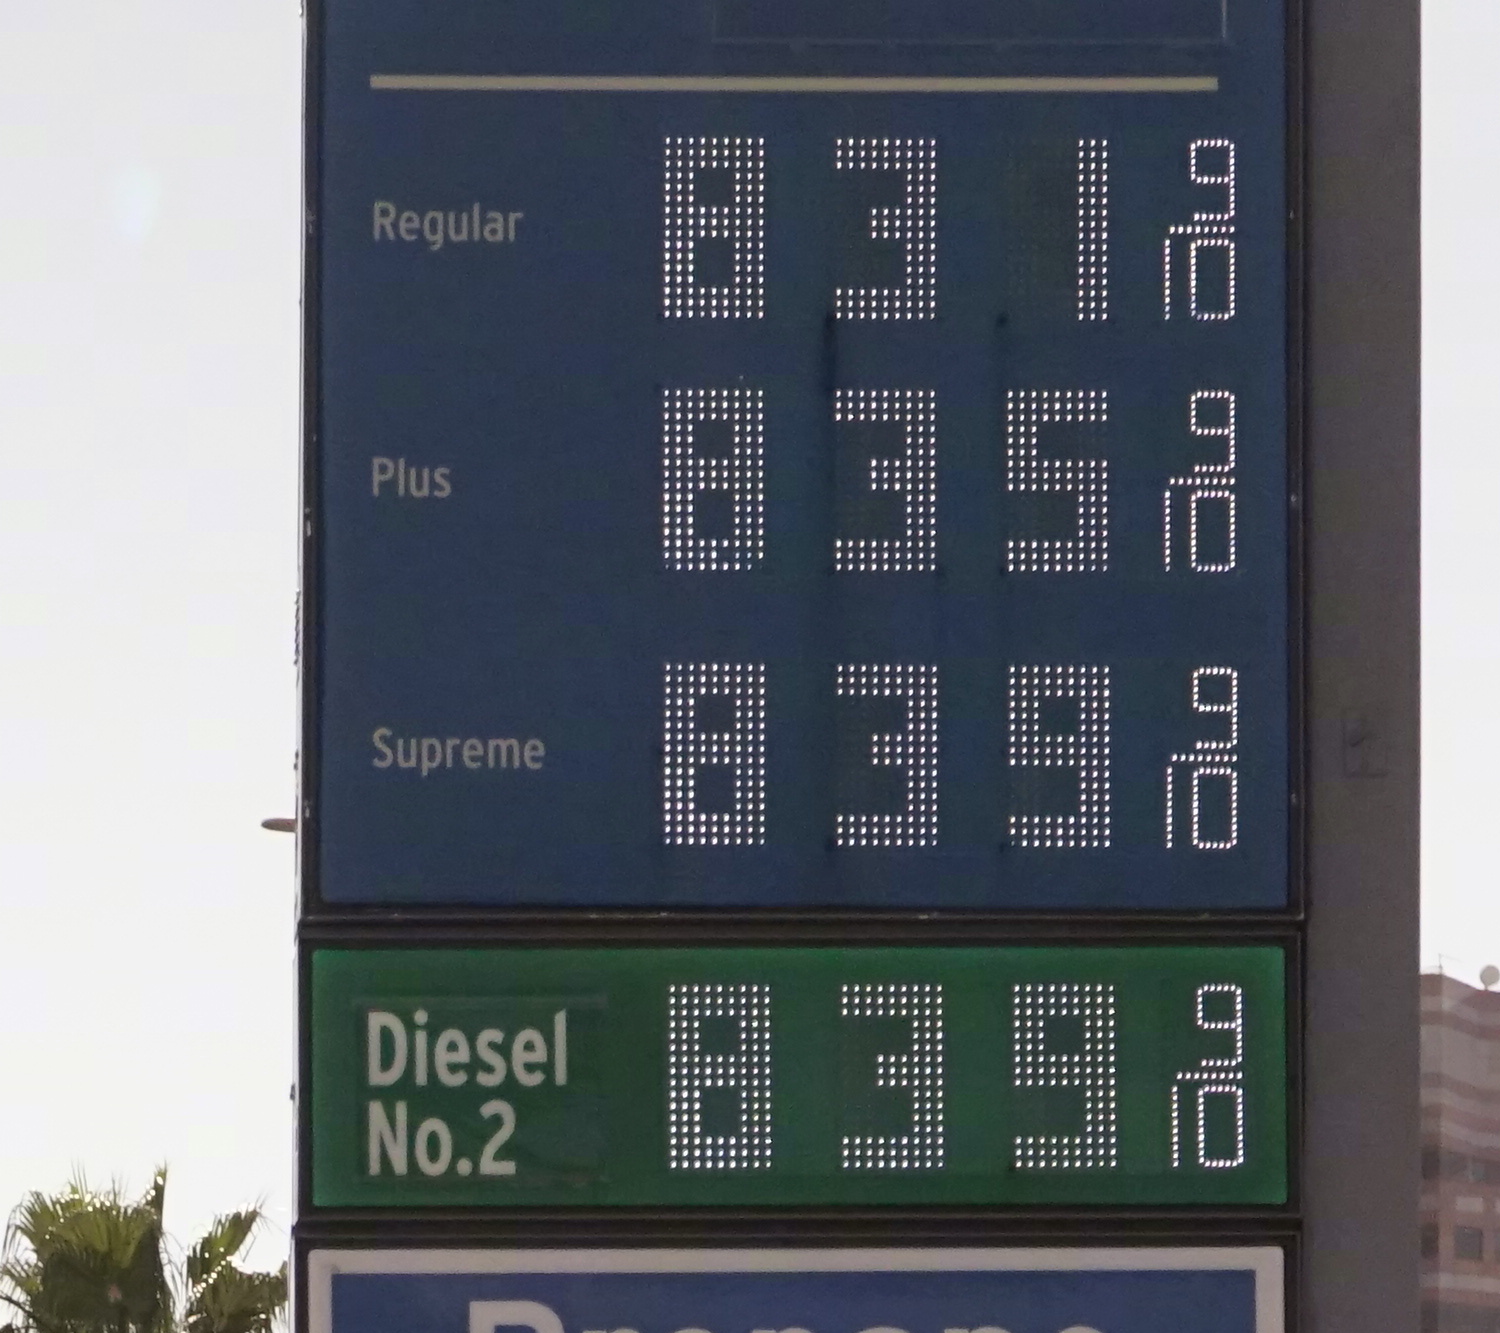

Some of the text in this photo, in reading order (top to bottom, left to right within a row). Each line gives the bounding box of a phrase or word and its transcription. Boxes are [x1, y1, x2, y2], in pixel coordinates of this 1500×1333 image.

[374, 202, 525, 252] Regular
[665, 137, 1110, 323] 831
[373, 458, 453, 499] Plus
[664, 389, 1110, 574] 835
[373, 729, 547, 778] Supreme
[665, 664, 1112, 850] 839
[367, 1010, 568, 1087] Diesel
[669, 984, 1119, 1170] 839
[368, 1100, 518, 1178] No.2
